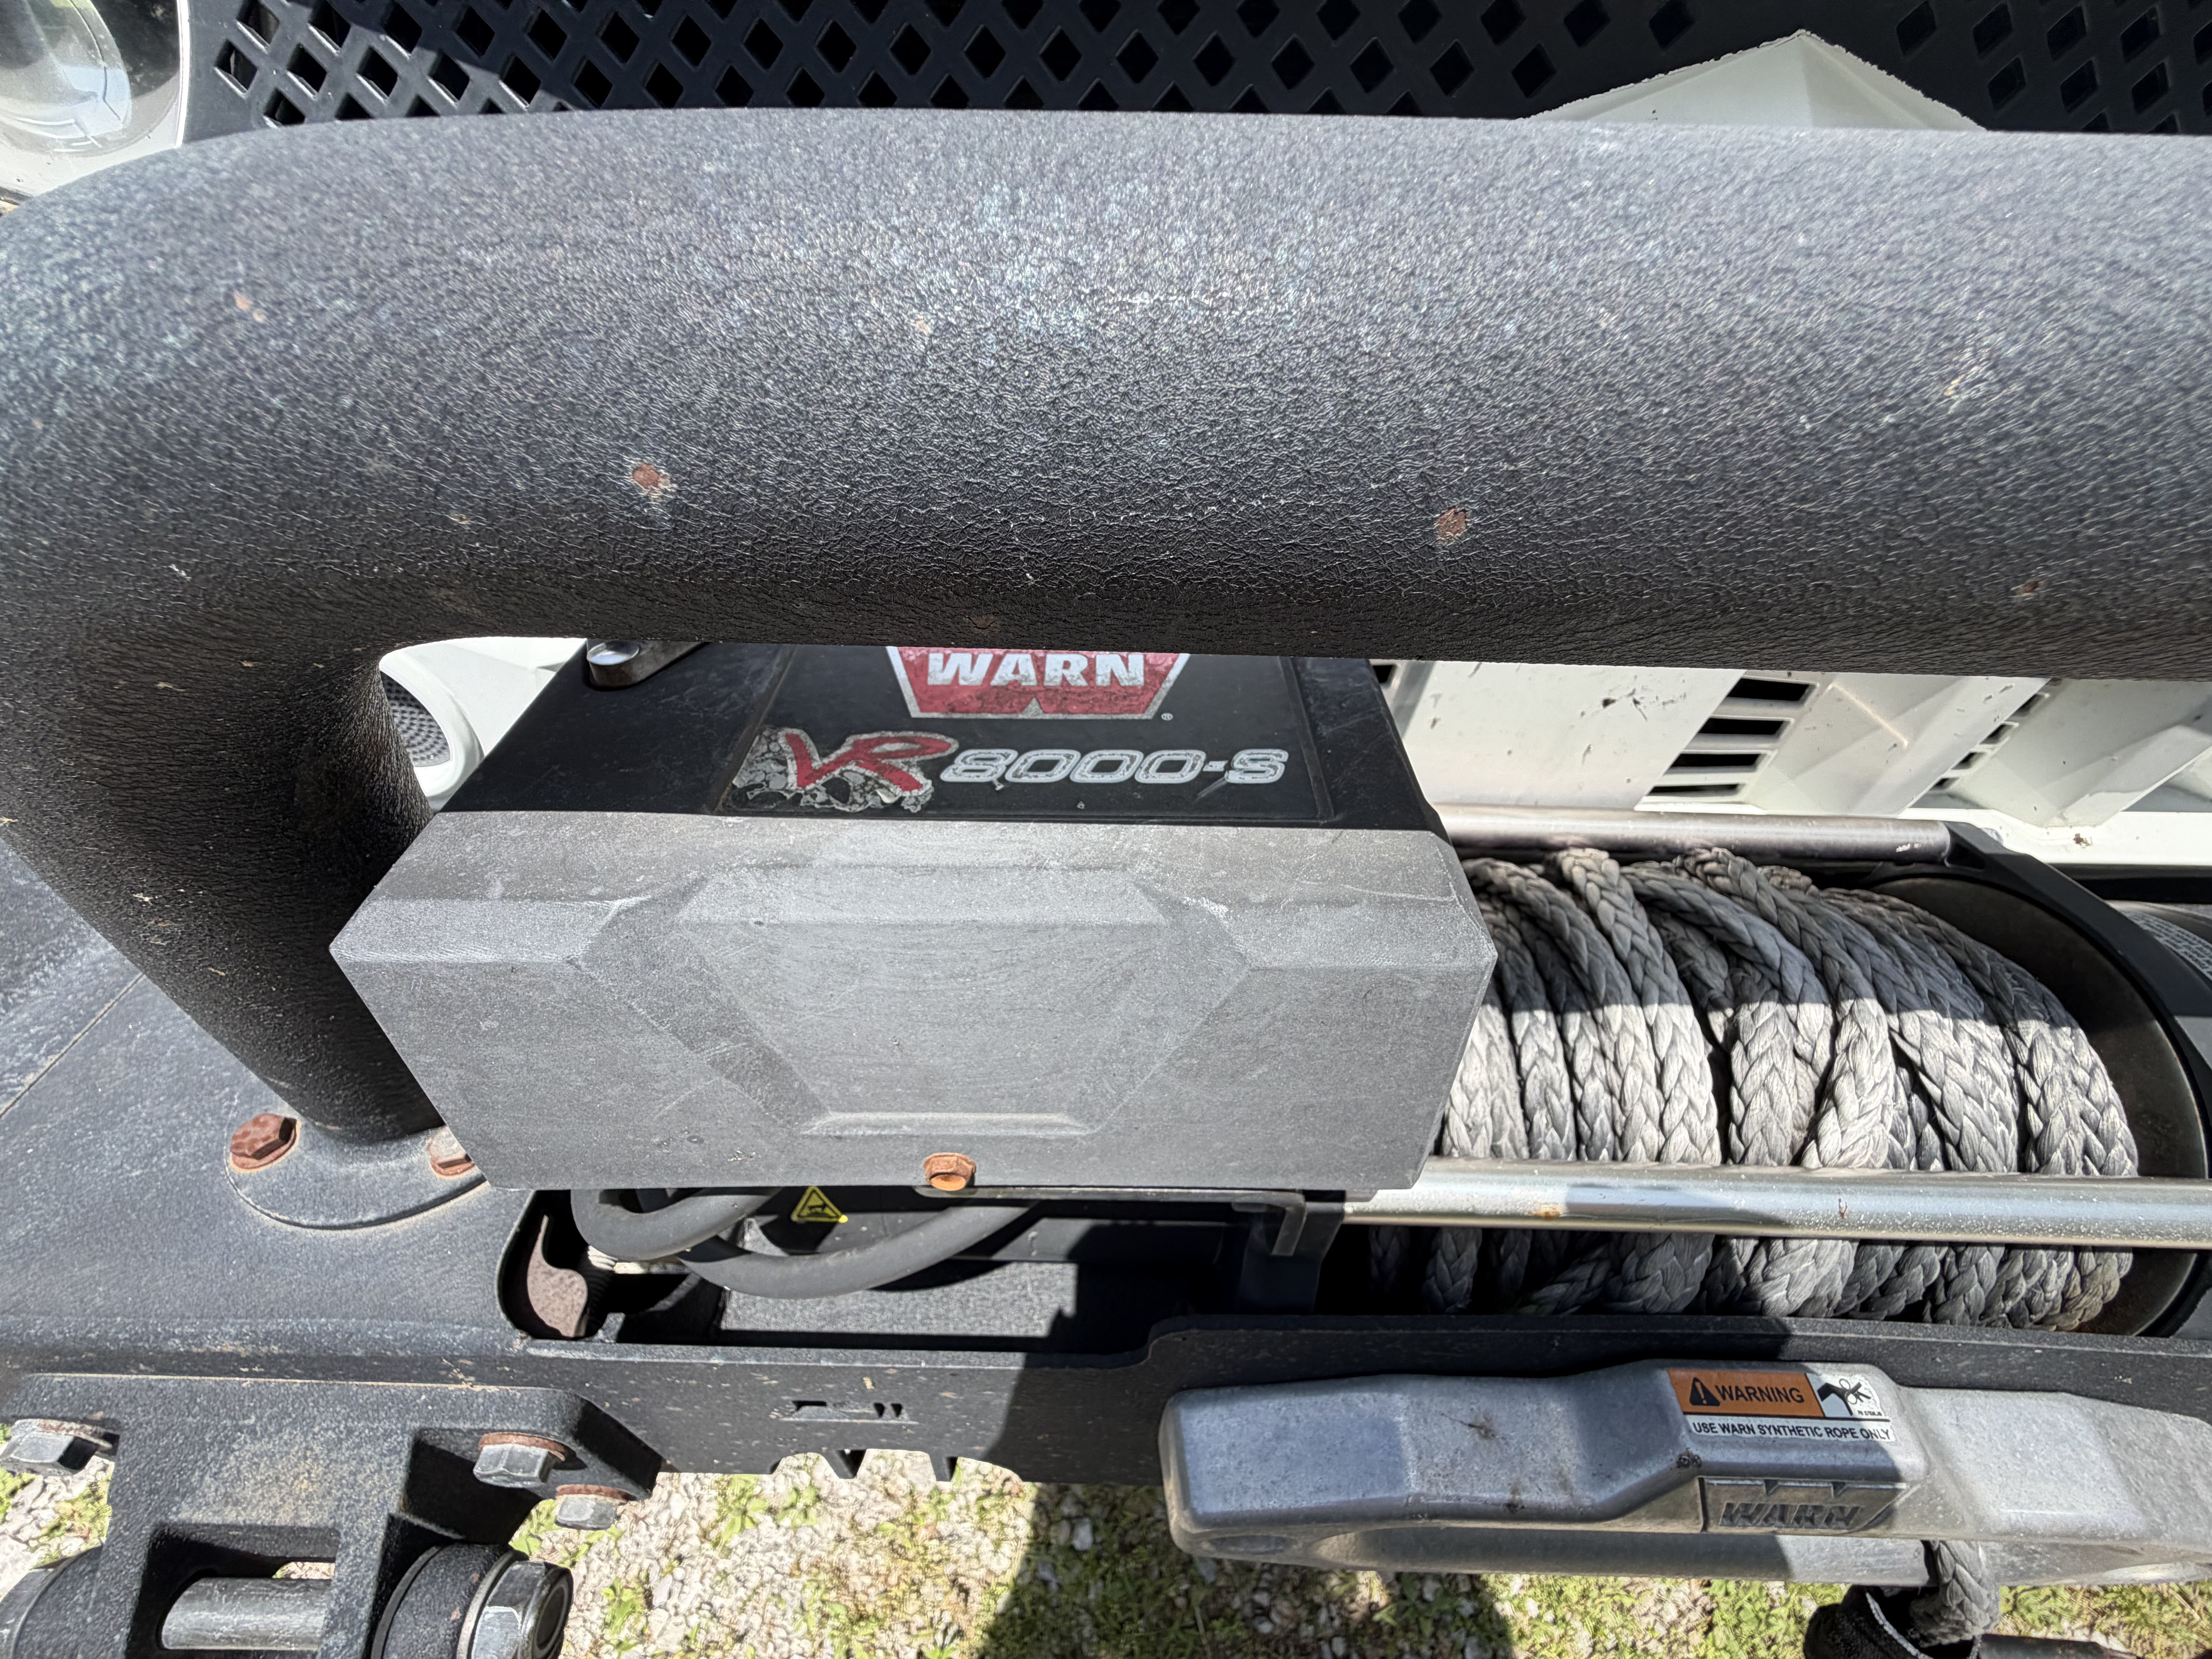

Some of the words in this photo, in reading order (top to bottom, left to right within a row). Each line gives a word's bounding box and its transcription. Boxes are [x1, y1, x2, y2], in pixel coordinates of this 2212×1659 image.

[927, 653, 1144, 686] WARN
[778, 728, 959, 798] VR
[940, 749, 1289, 784] 8000-S
[1715, 1385, 1805, 1403] WARNING
[1693, 1422, 1718, 1433] USE
[1718, 1423, 1756, 1434] WARN
[1758, 1424, 1823, 1437] SYNTHETIC
[1824, 1427, 1858, 1439] ROPE
[1860, 1428, 1890, 1439] ONLY
